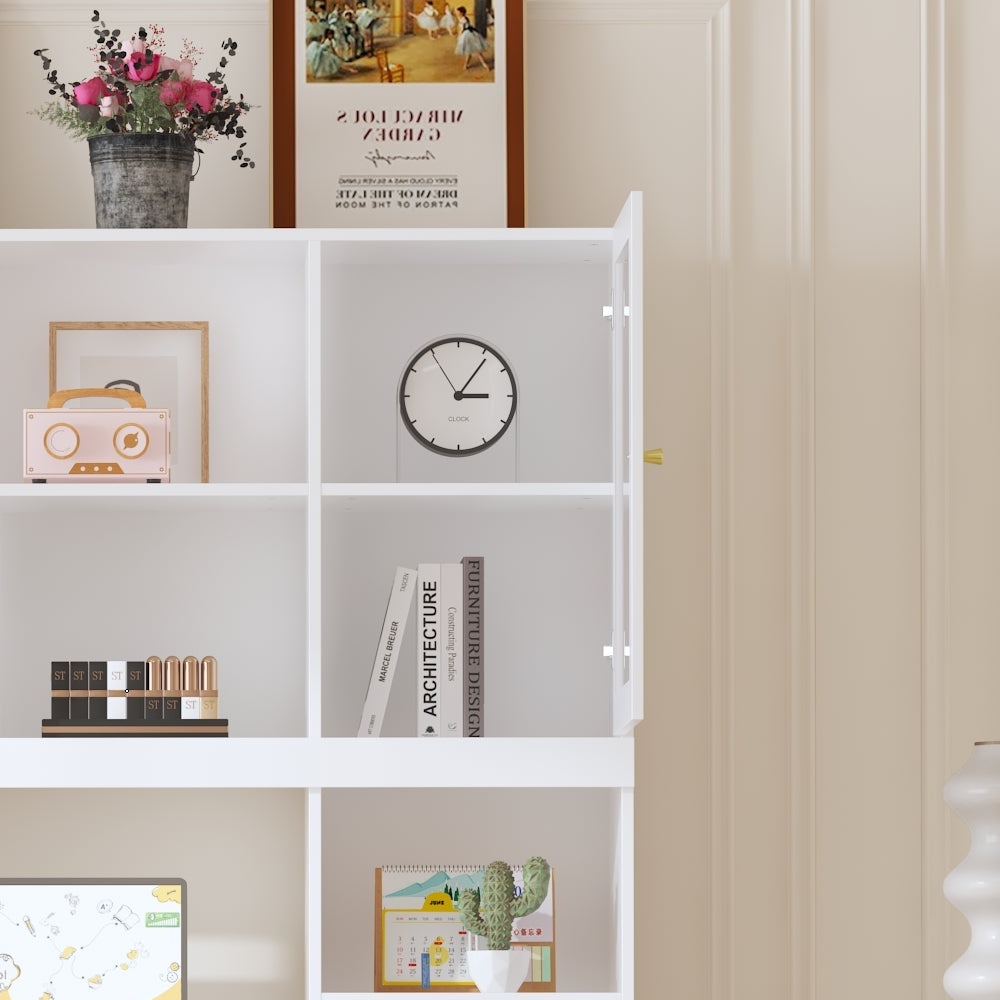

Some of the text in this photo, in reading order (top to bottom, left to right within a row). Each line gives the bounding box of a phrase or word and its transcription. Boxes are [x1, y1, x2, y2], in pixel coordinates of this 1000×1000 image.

[399, 572, 410, 592] TASCEN
[445, 606, 457, 652] Constructing
[378, 621, 400, 683] MARCEL BREUER
[423, 581, 437, 717] ARCHITECTURE
[468, 560, 480, 737] FURNITURE DESIGN
[54, 670, 66, 680] ST
[73, 670, 85, 680] ST
[92, 670, 104, 680] ST
[111, 670, 123, 680] ST
[129, 670, 142, 680] ST
[148, 700, 160, 710] ST
[166, 700, 179, 710] ST
[185, 700, 197, 710] ST
